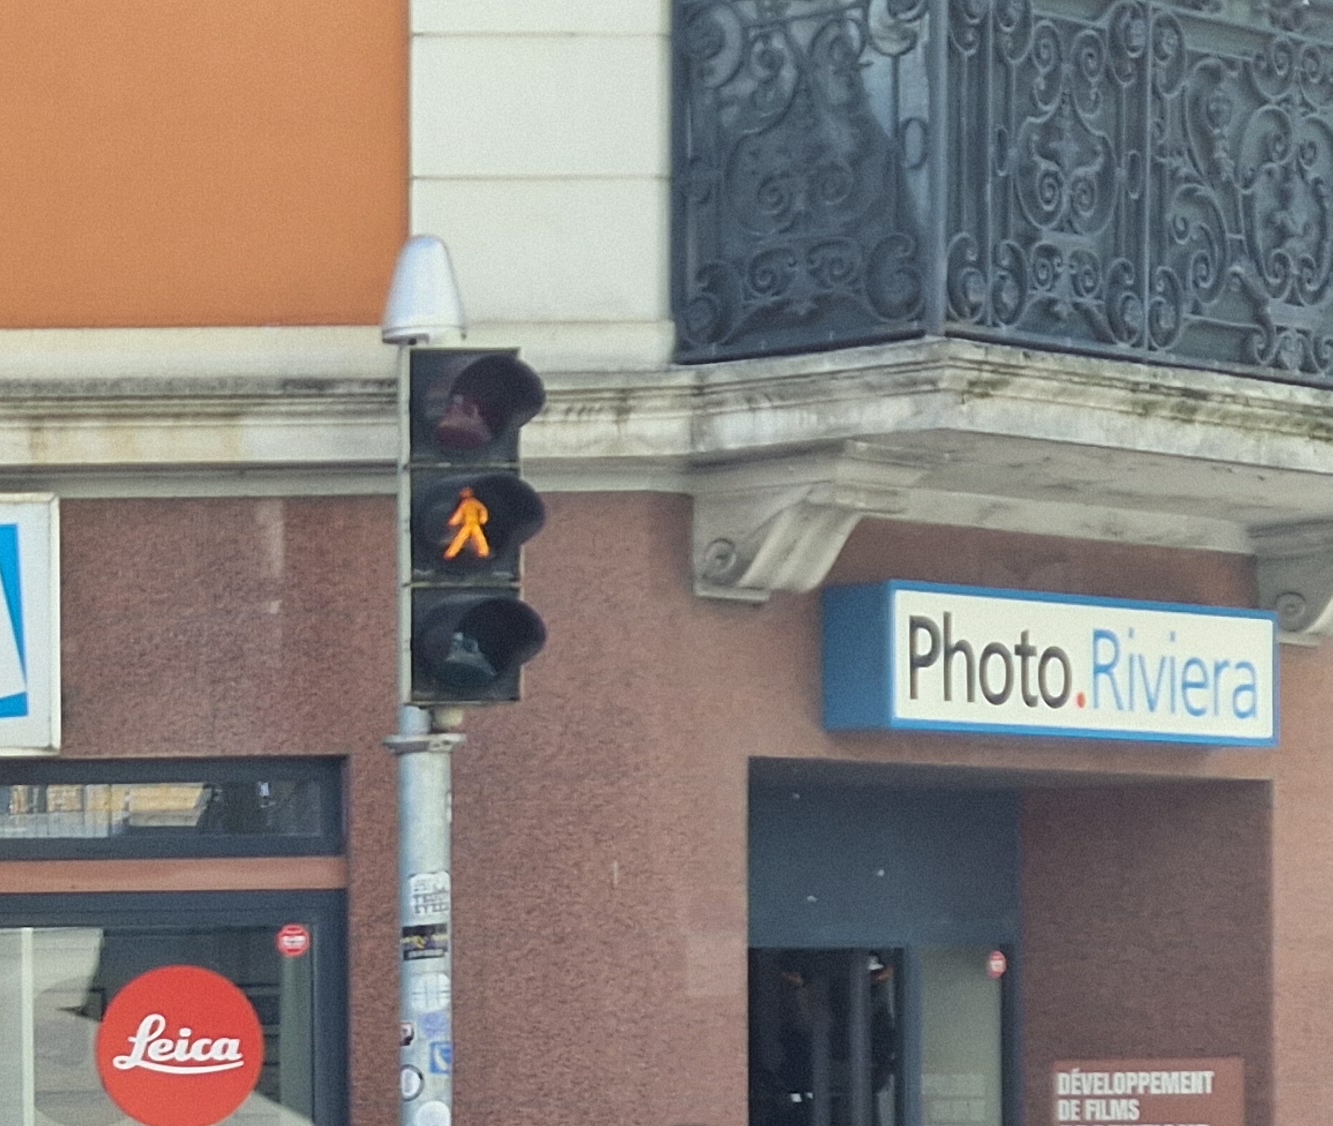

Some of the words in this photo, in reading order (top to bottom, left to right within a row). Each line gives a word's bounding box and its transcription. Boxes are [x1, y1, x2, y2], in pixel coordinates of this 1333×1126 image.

[112, 1013, 245, 1075] Leica
[1056, 1067, 1215, 1095] DÉVELOPPEMENT
[1057, 1099, 1081, 1121] DE
[1085, 1099, 1140, 1121] FILMS
